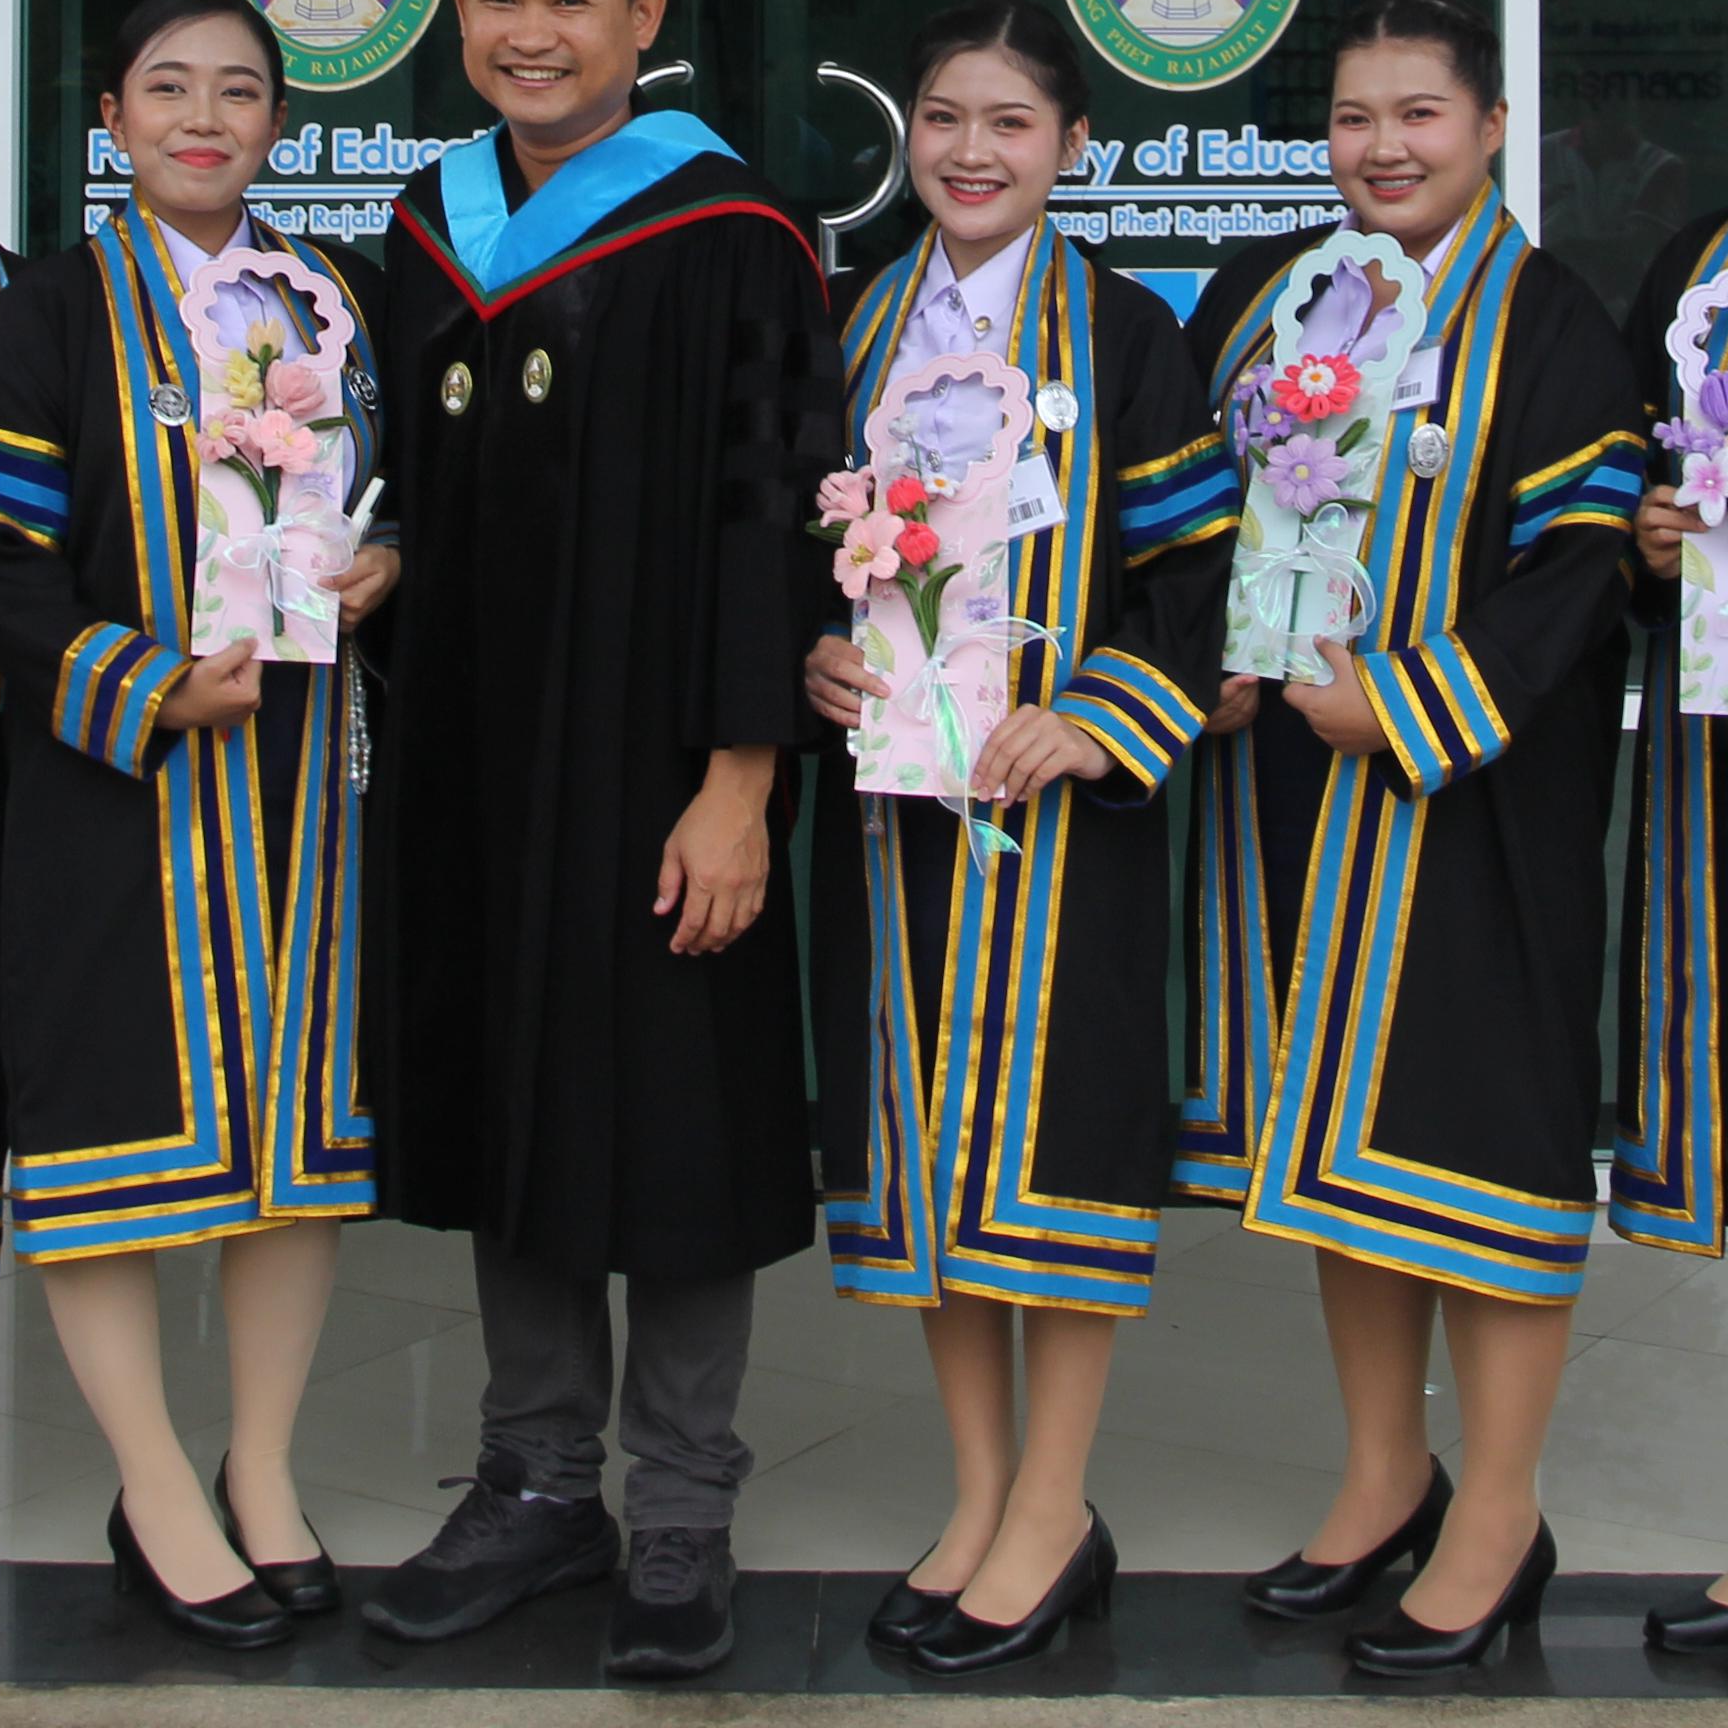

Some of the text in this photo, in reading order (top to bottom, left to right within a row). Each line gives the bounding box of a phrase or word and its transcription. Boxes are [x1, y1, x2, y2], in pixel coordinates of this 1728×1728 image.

[310, 20, 407, 78] RAJABHAT
[1106, 27, 1154, 68] PHET
[1166, 22, 1267, 78] RAJABHAT
[270, 125, 321, 173] of
[1135, 125, 1188, 175] of
[1199, 125, 1332, 175] Educa
[249, 203, 393, 241] Phet Rajab
[1112, 204, 1172, 236] Phet
[1176, 204, 1297, 243] Rajabhat
